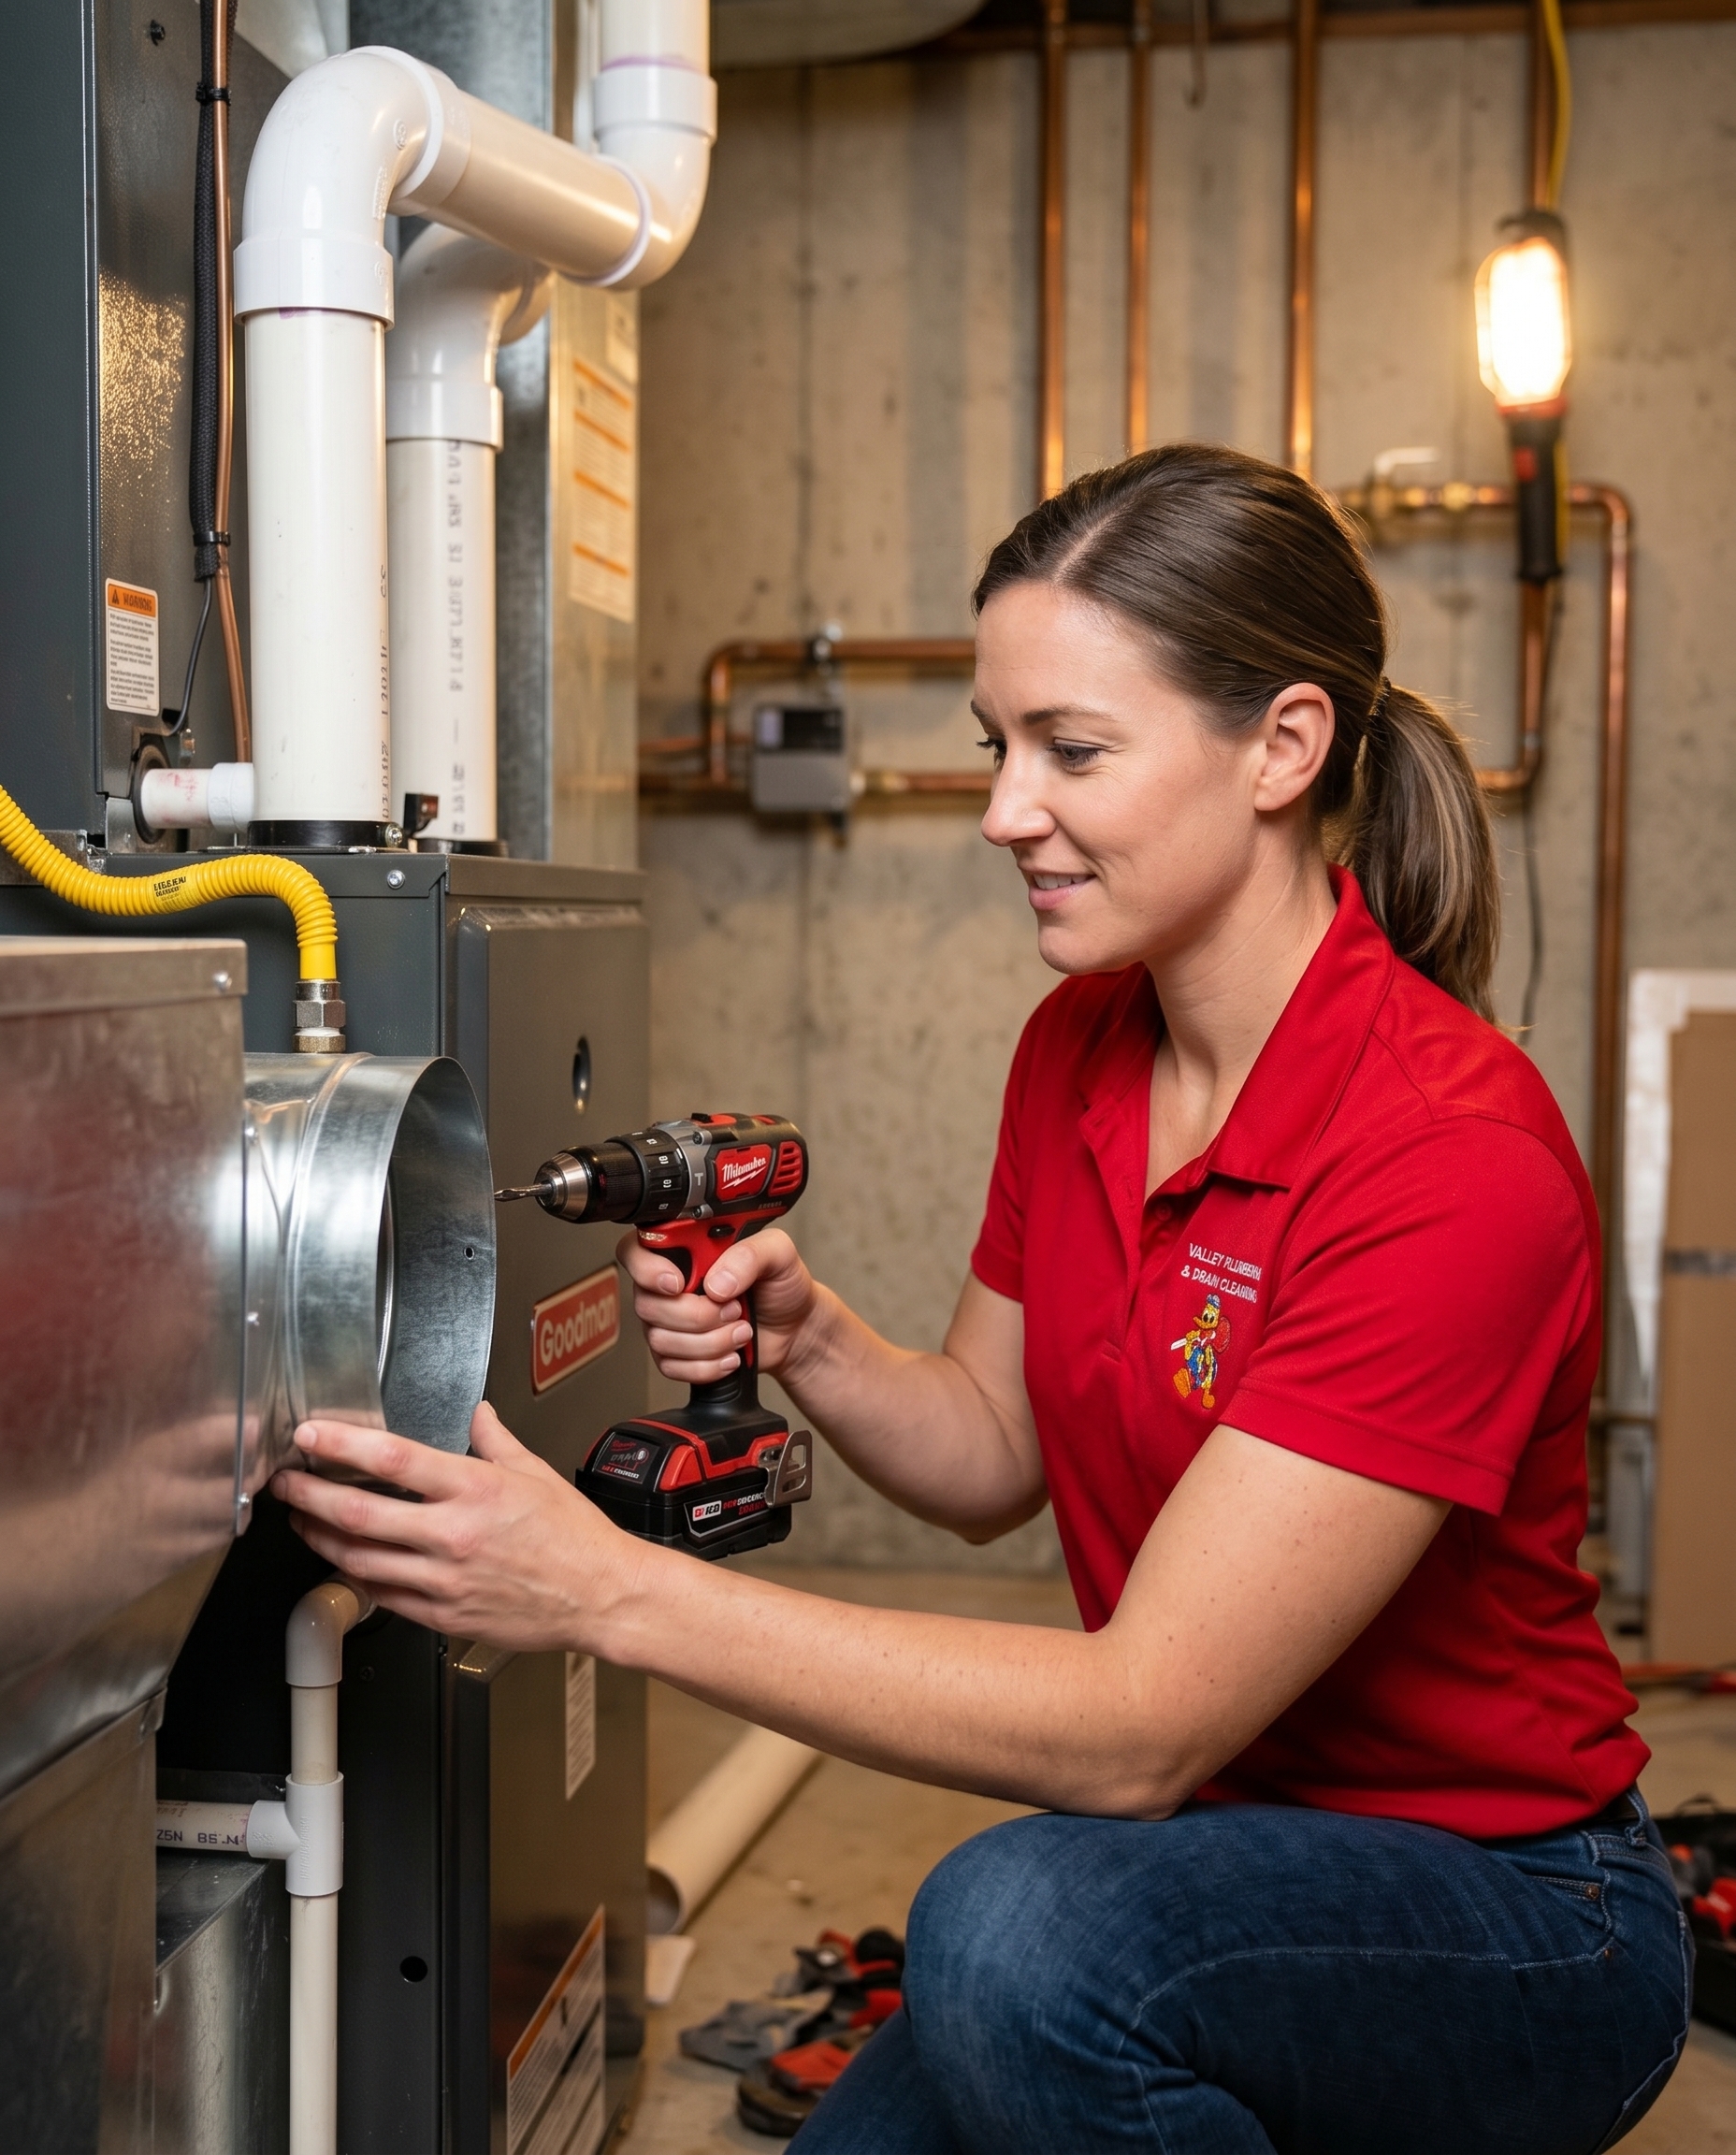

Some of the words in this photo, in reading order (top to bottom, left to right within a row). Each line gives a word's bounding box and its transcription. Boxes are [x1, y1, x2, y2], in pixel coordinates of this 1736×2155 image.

[1189, 1242, 1225, 1267] VALLEY
[1180, 1265, 1191, 1278] &
[540, 1293, 616, 1367] Goodman
